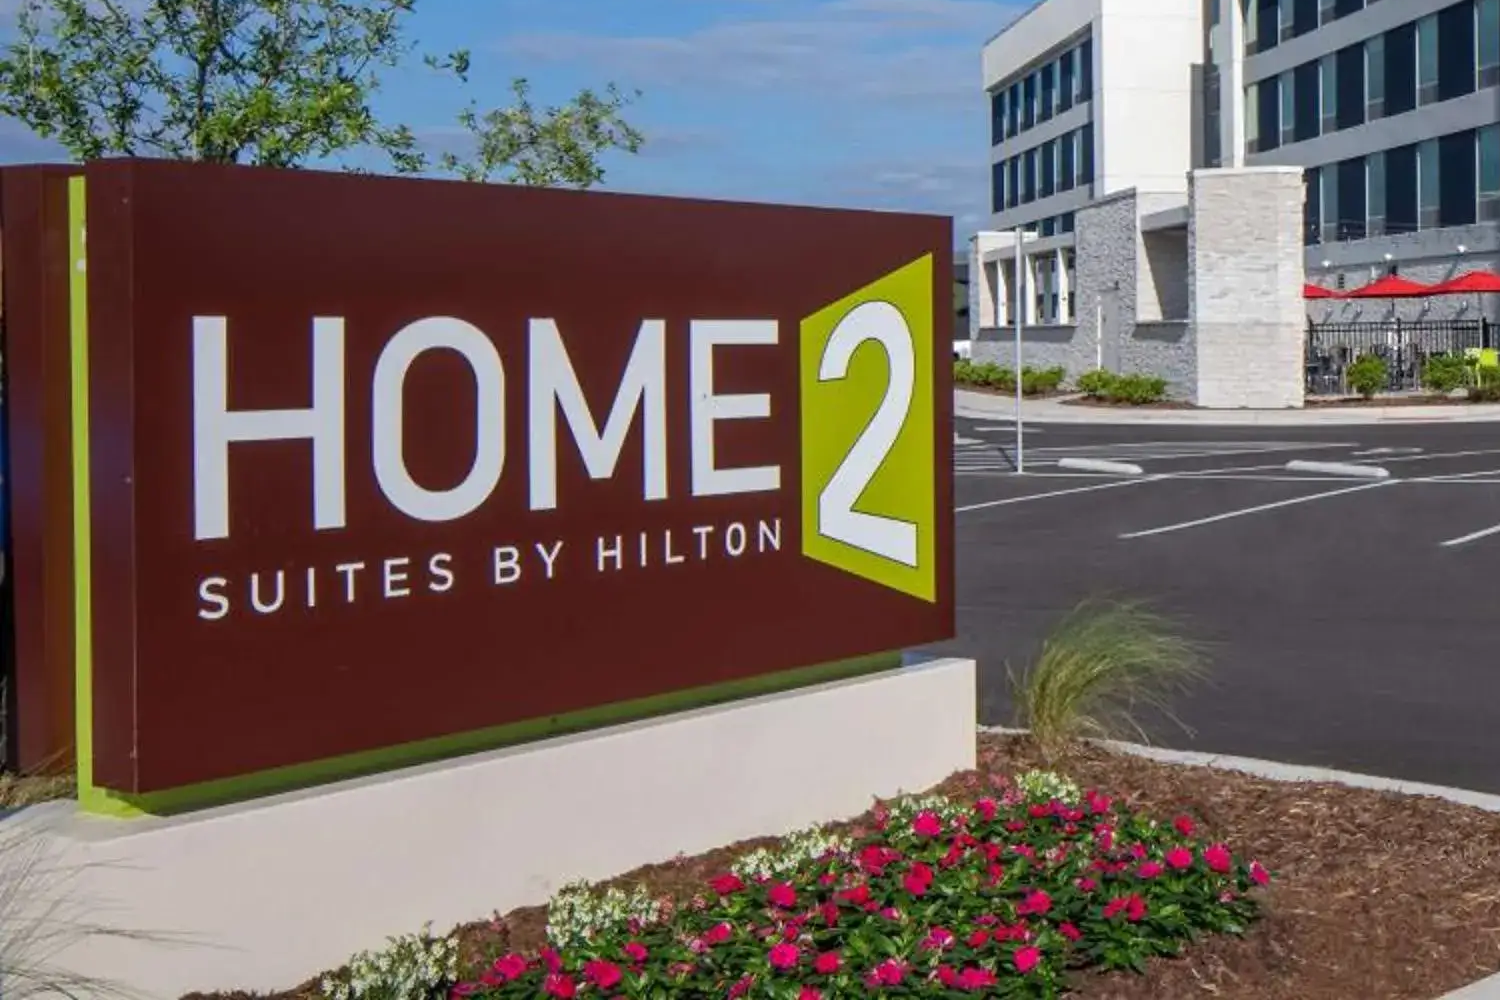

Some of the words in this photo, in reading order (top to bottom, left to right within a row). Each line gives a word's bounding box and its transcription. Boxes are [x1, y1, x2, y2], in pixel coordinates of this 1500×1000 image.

[199, 552, 454, 620] SUITES
[494, 541, 564, 584] BY
[597, 519, 782, 571] HILTON
